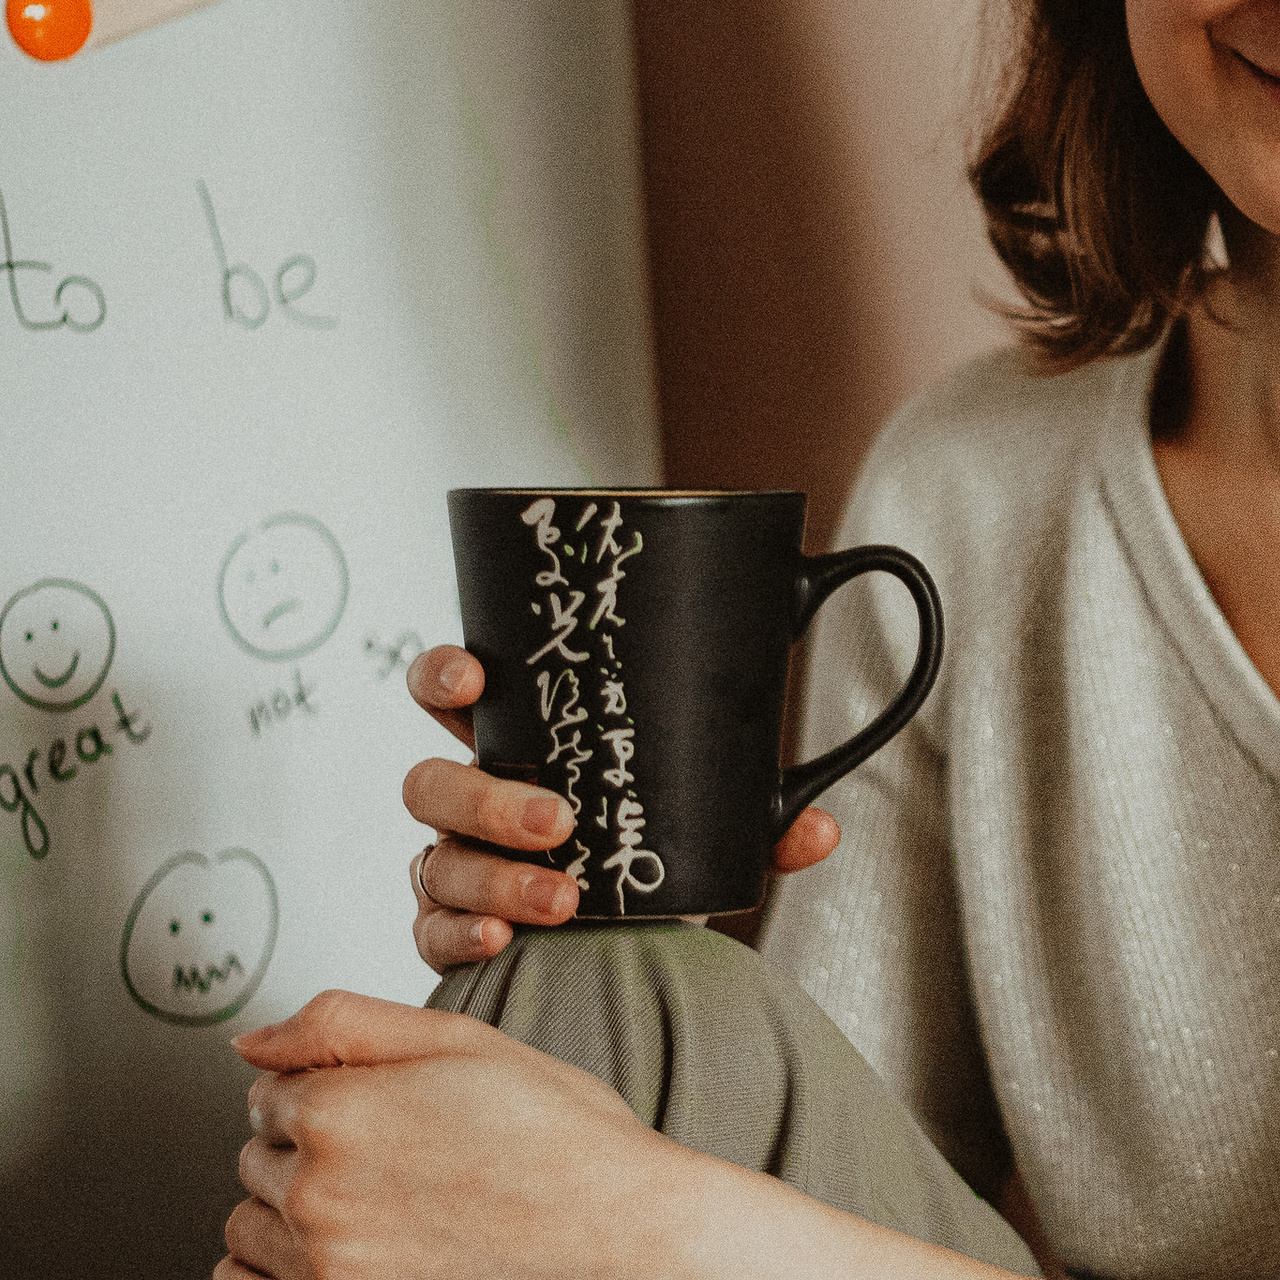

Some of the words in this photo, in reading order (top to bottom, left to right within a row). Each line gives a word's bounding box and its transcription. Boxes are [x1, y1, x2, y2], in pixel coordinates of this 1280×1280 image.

[0, 187, 107, 334] to
[195, 177, 336, 331] be
[0, 689, 153, 861] great
[248, 668, 318, 738] not
